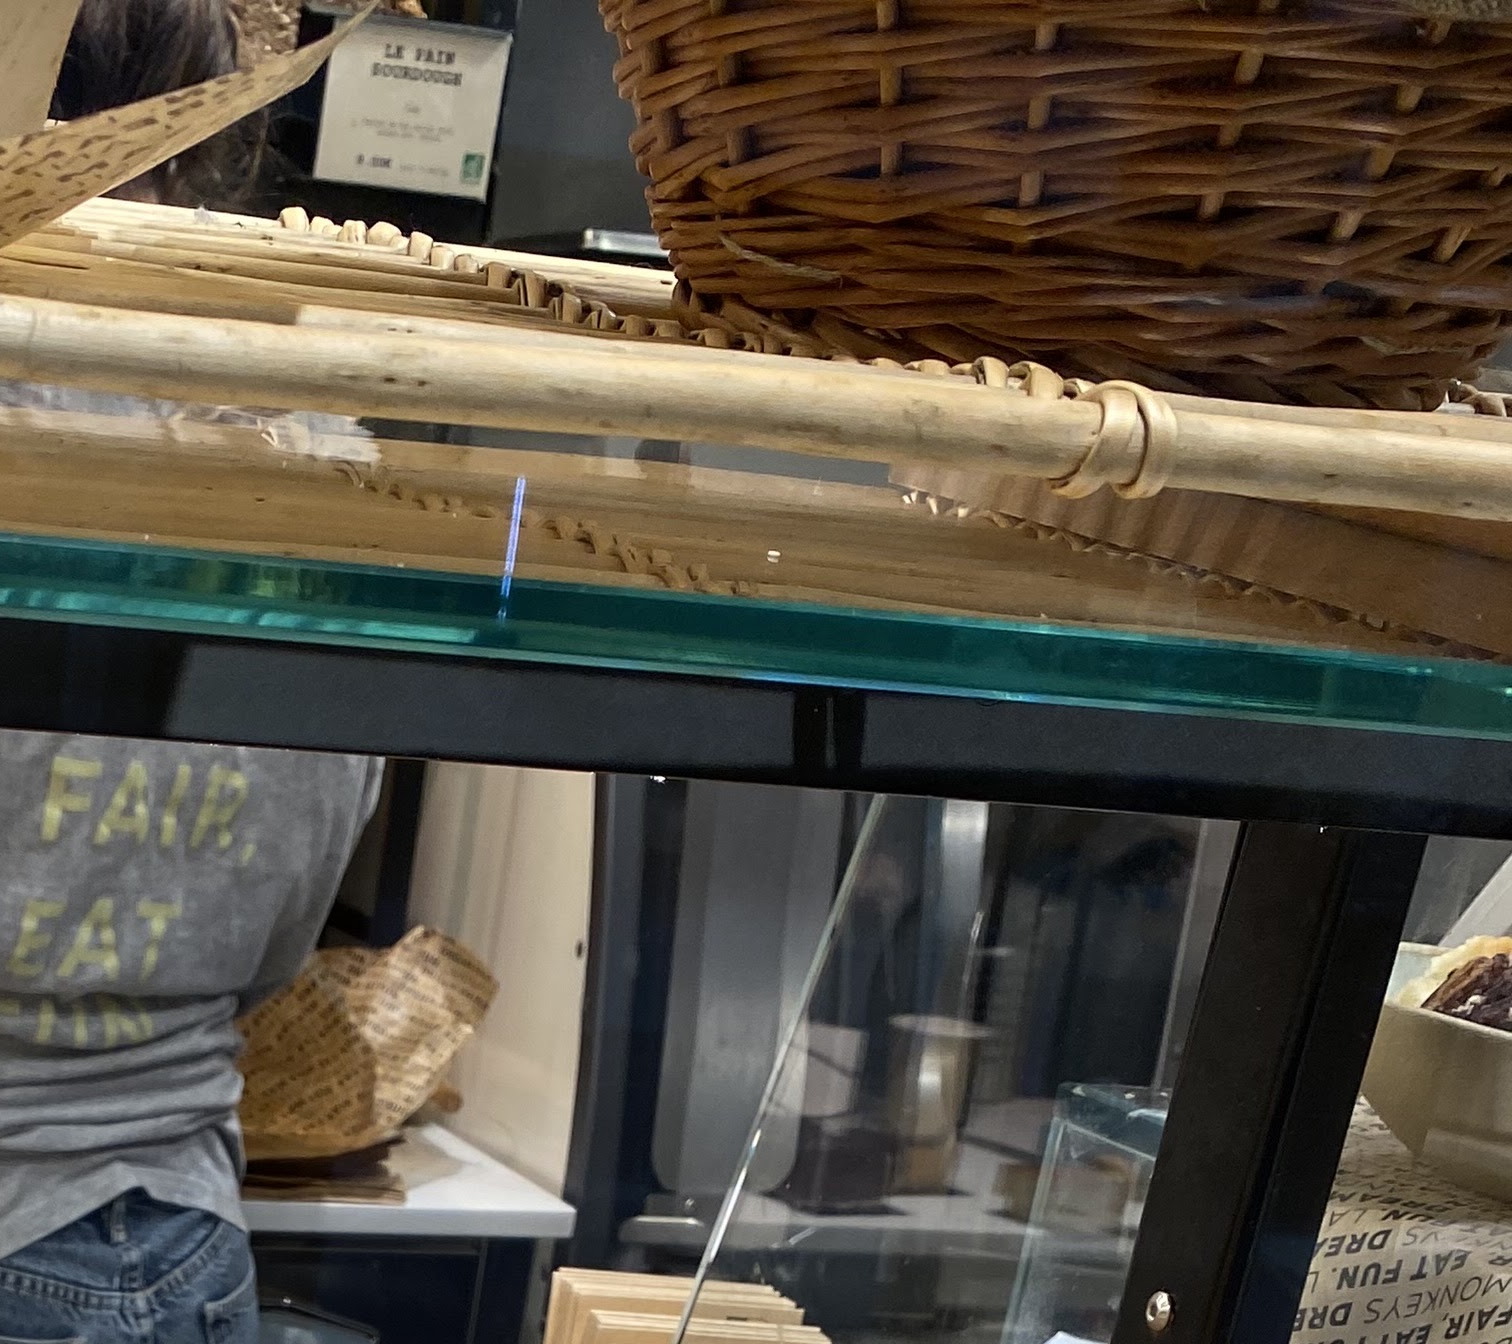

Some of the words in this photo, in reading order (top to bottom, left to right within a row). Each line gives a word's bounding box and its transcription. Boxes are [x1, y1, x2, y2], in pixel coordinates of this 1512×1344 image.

[41, 756, 256, 866] FAIR,
[6, 899, 183, 980] EAT
[1332, 1260, 1404, 1291] FUN.
[1410, 1249, 1472, 1280] EAT
[1292, 1302, 1353, 1333] DRE
[1364, 1274, 1512, 1324] MONKEYS
